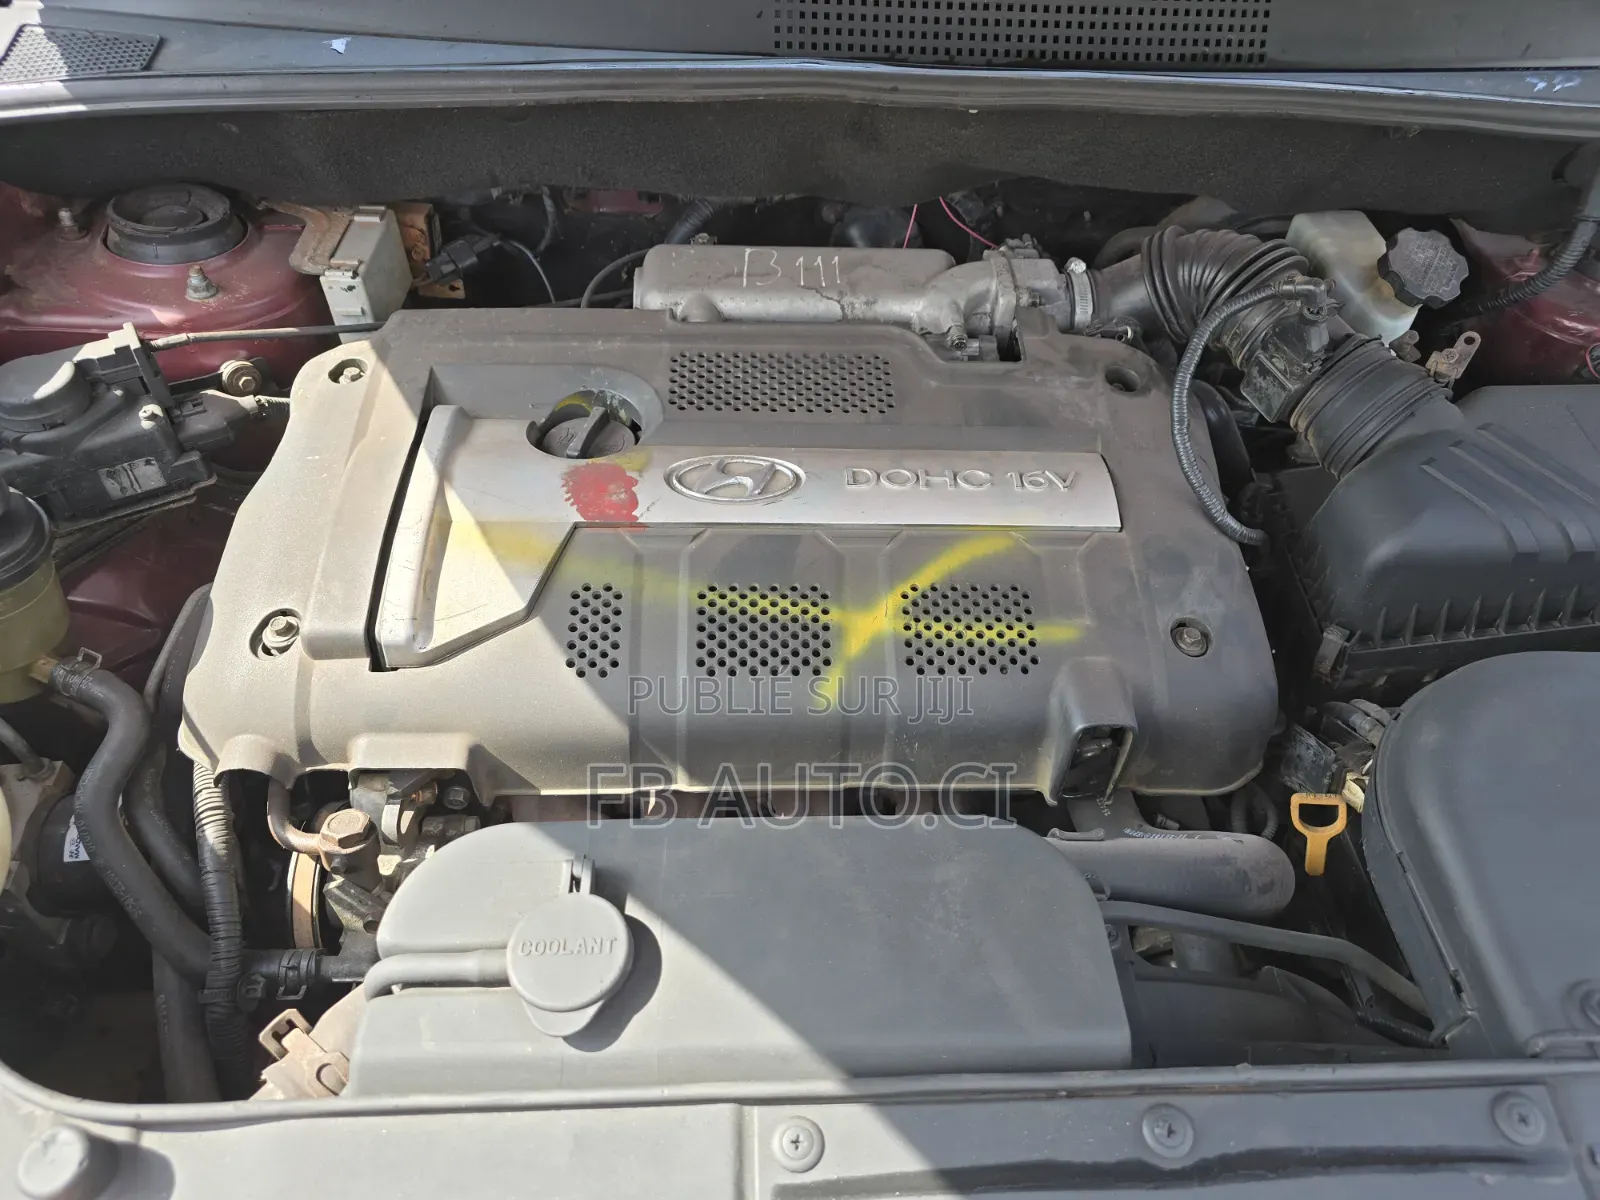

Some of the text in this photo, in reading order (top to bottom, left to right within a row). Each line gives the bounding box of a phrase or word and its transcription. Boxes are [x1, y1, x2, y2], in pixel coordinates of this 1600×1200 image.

[845, 467, 1076, 492] DOHC 16V
[520, 937, 618, 957] COOLANT
